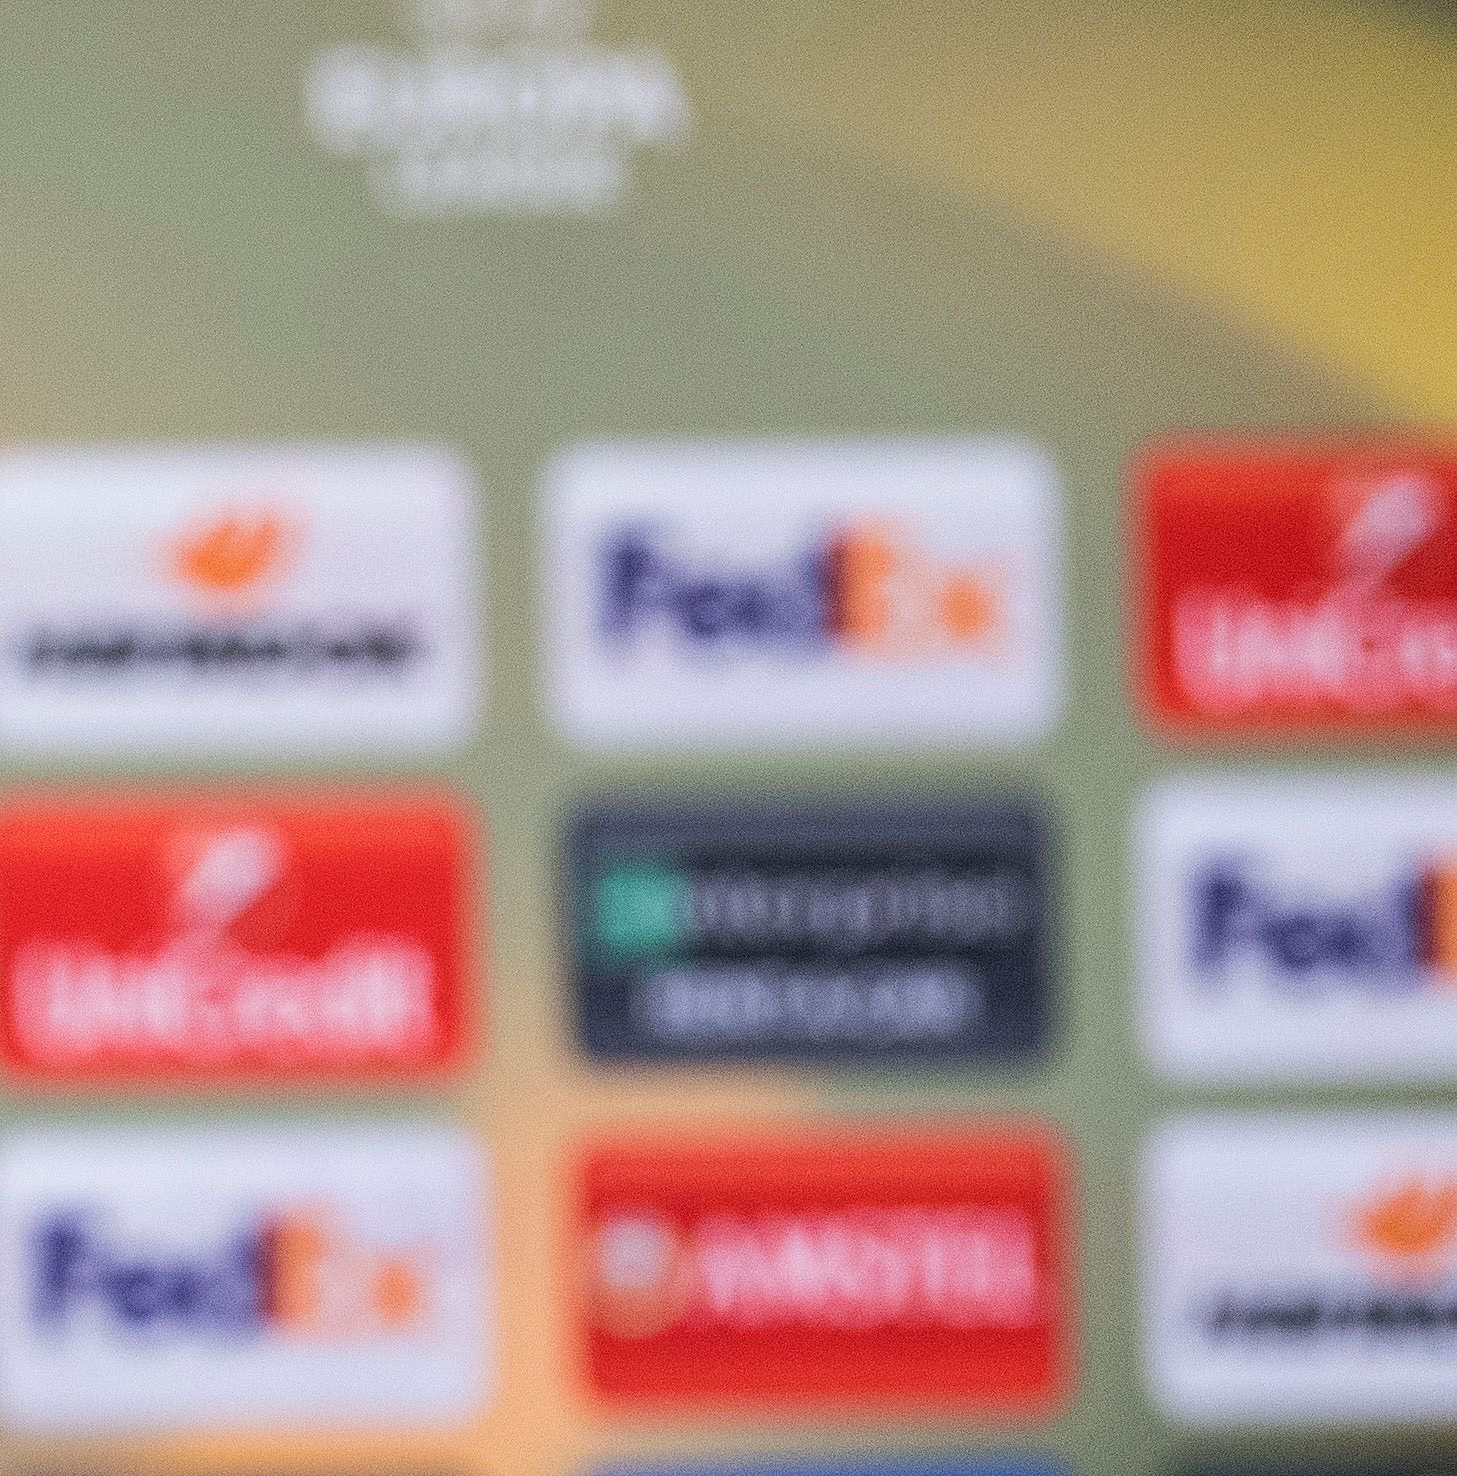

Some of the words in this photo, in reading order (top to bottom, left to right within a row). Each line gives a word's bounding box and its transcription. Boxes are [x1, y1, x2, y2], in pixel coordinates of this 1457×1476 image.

[595, 512, 1027, 672] FedEx
[9, 940, 439, 1070] UniCredit
[27, 1205, 445, 1352] FedEx
[692, 1205, 1039, 1332] AMSTEL
